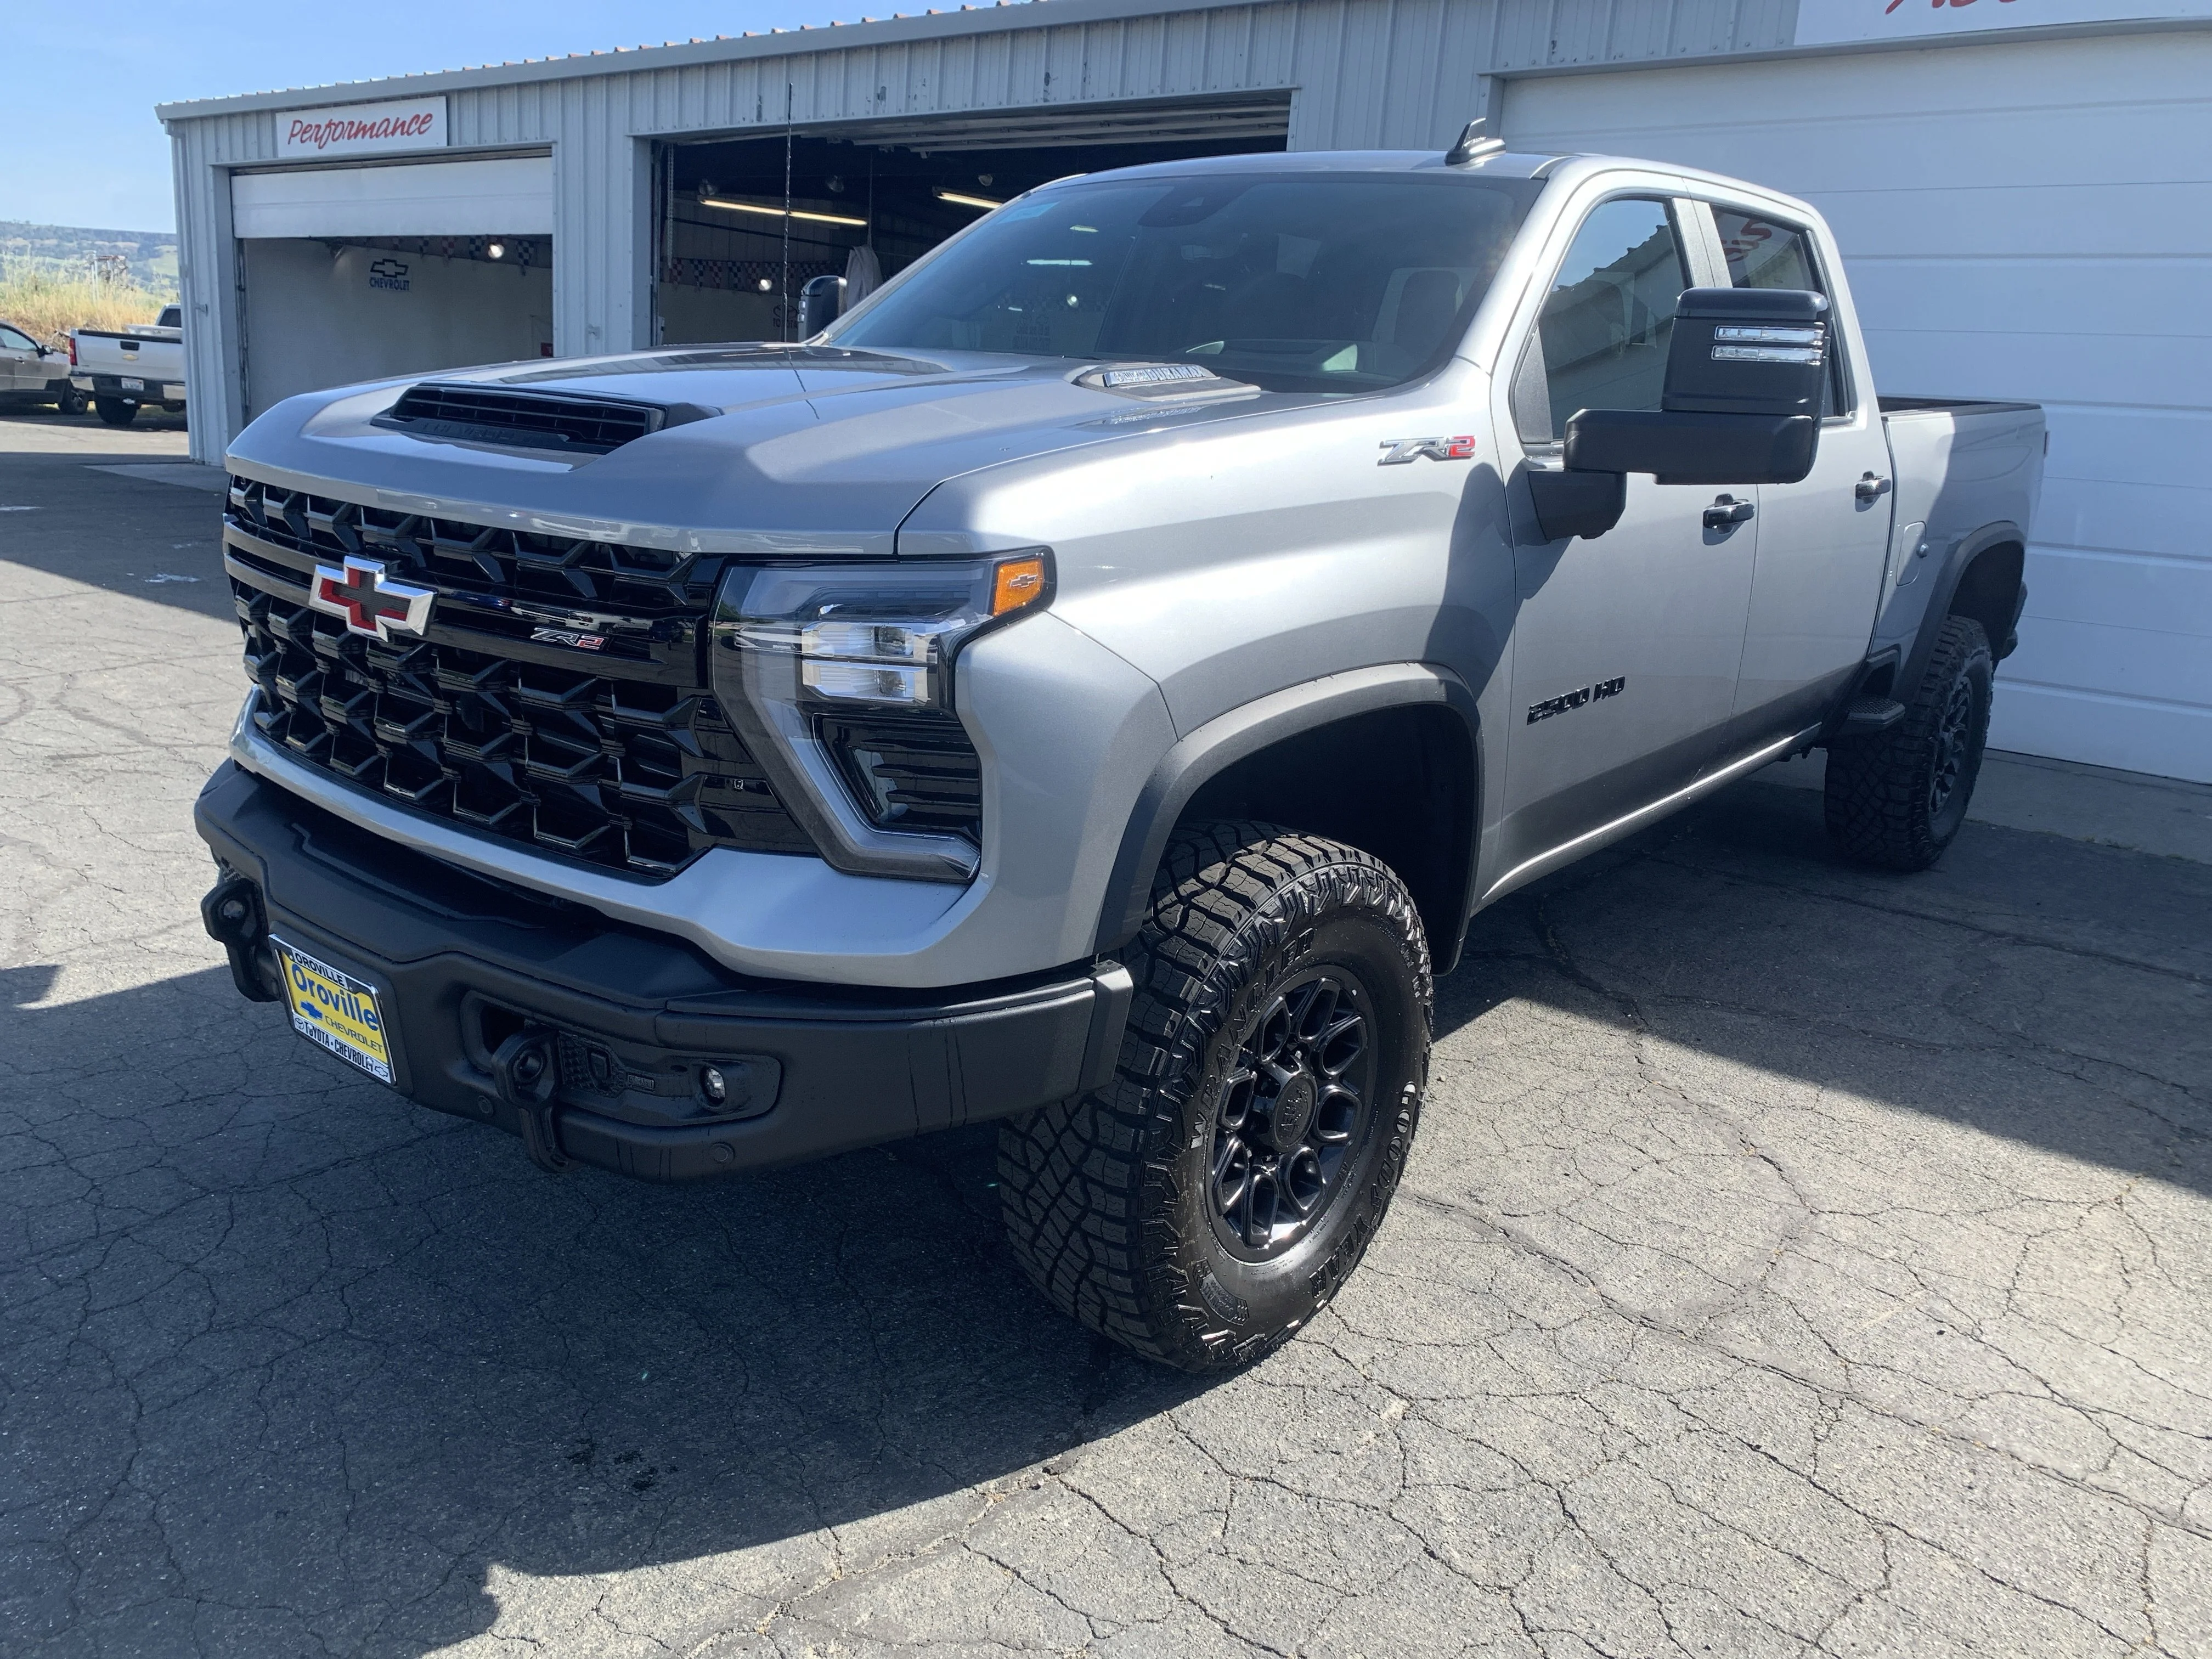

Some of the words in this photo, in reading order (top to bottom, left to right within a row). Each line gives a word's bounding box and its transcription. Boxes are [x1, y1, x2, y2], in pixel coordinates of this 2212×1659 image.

[287, 113, 433, 150] Performance
[370, 277, 410, 291] CHEVROLET
[1146, 365, 1206, 381] DURAMAX
[1377, 435, 1476, 467] ZR2
[530, 627, 605, 650] ZR2
[1527, 686, 1590, 726] 2500
[1593, 675, 1626, 703] HD
[295, 952, 343, 986] OROVILLE
[291, 963, 379, 1031] Oroville
[304, 1021, 329, 1047] TOYOTA
[325, 1015, 383, 1053] CHEVROLET
[1309, 1081, 1416, 1299] GOODYEAR
